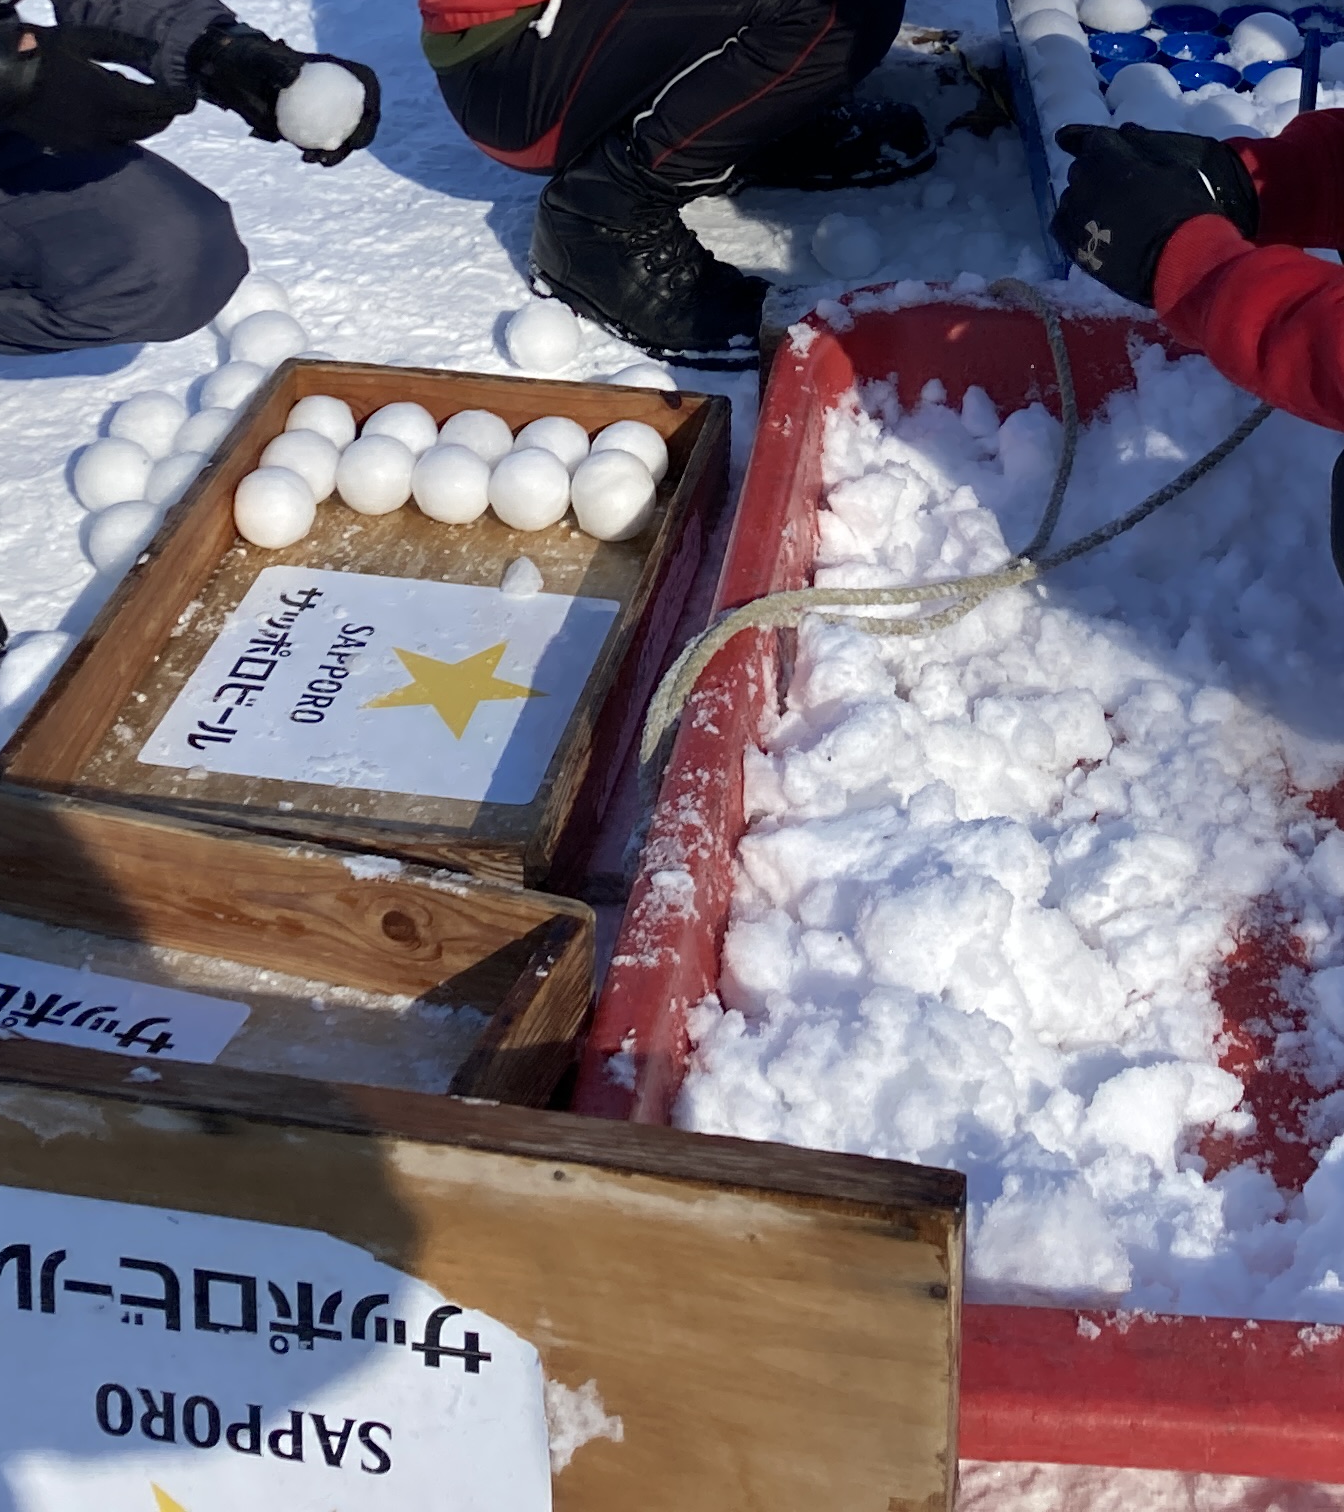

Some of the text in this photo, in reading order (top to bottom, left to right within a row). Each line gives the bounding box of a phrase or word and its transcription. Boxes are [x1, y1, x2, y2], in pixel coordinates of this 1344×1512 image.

[186, 587, 324, 751] サッポロビール
[289, 621, 375, 724] SAPPORO
[95, 1383, 393, 1476] SAPPORO
